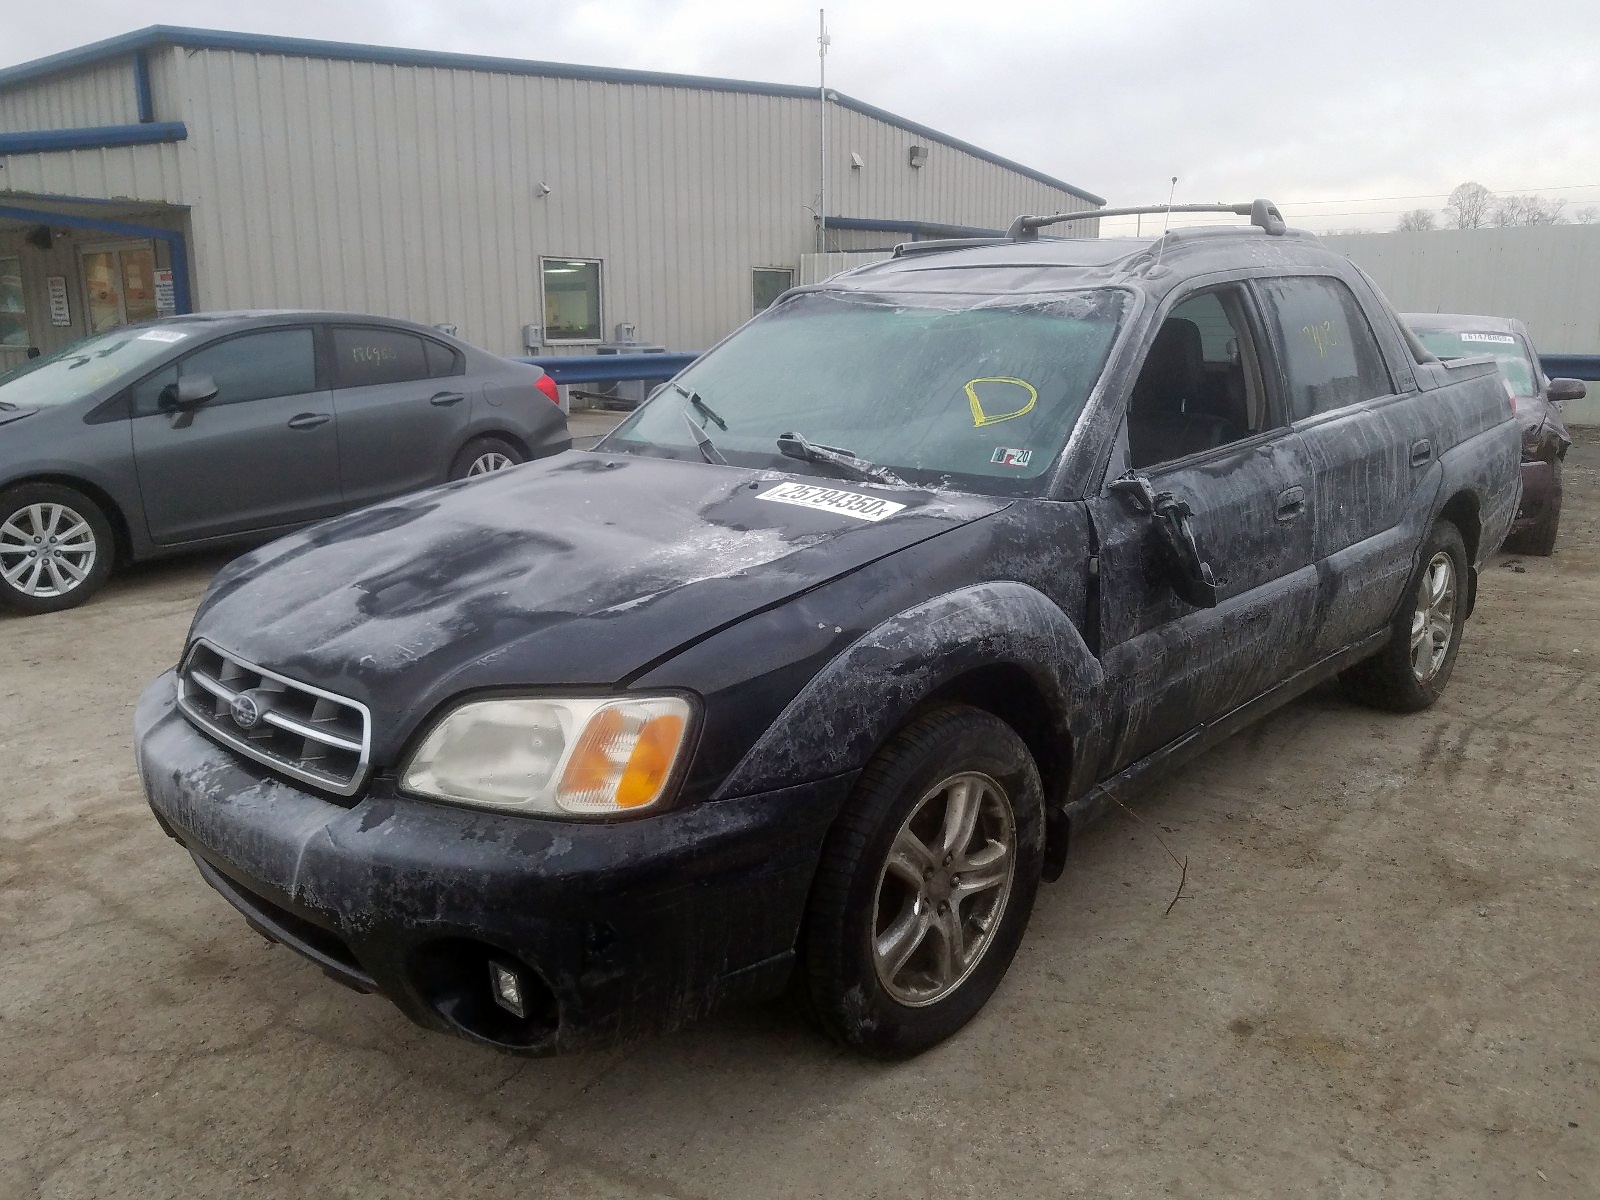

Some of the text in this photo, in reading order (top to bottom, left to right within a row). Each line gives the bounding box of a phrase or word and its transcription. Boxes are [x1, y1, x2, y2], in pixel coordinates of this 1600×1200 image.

[964, 376, 1038, 428] D
[1016, 450, 1030, 463] 20
[778, 485, 887, 514] 25794350
